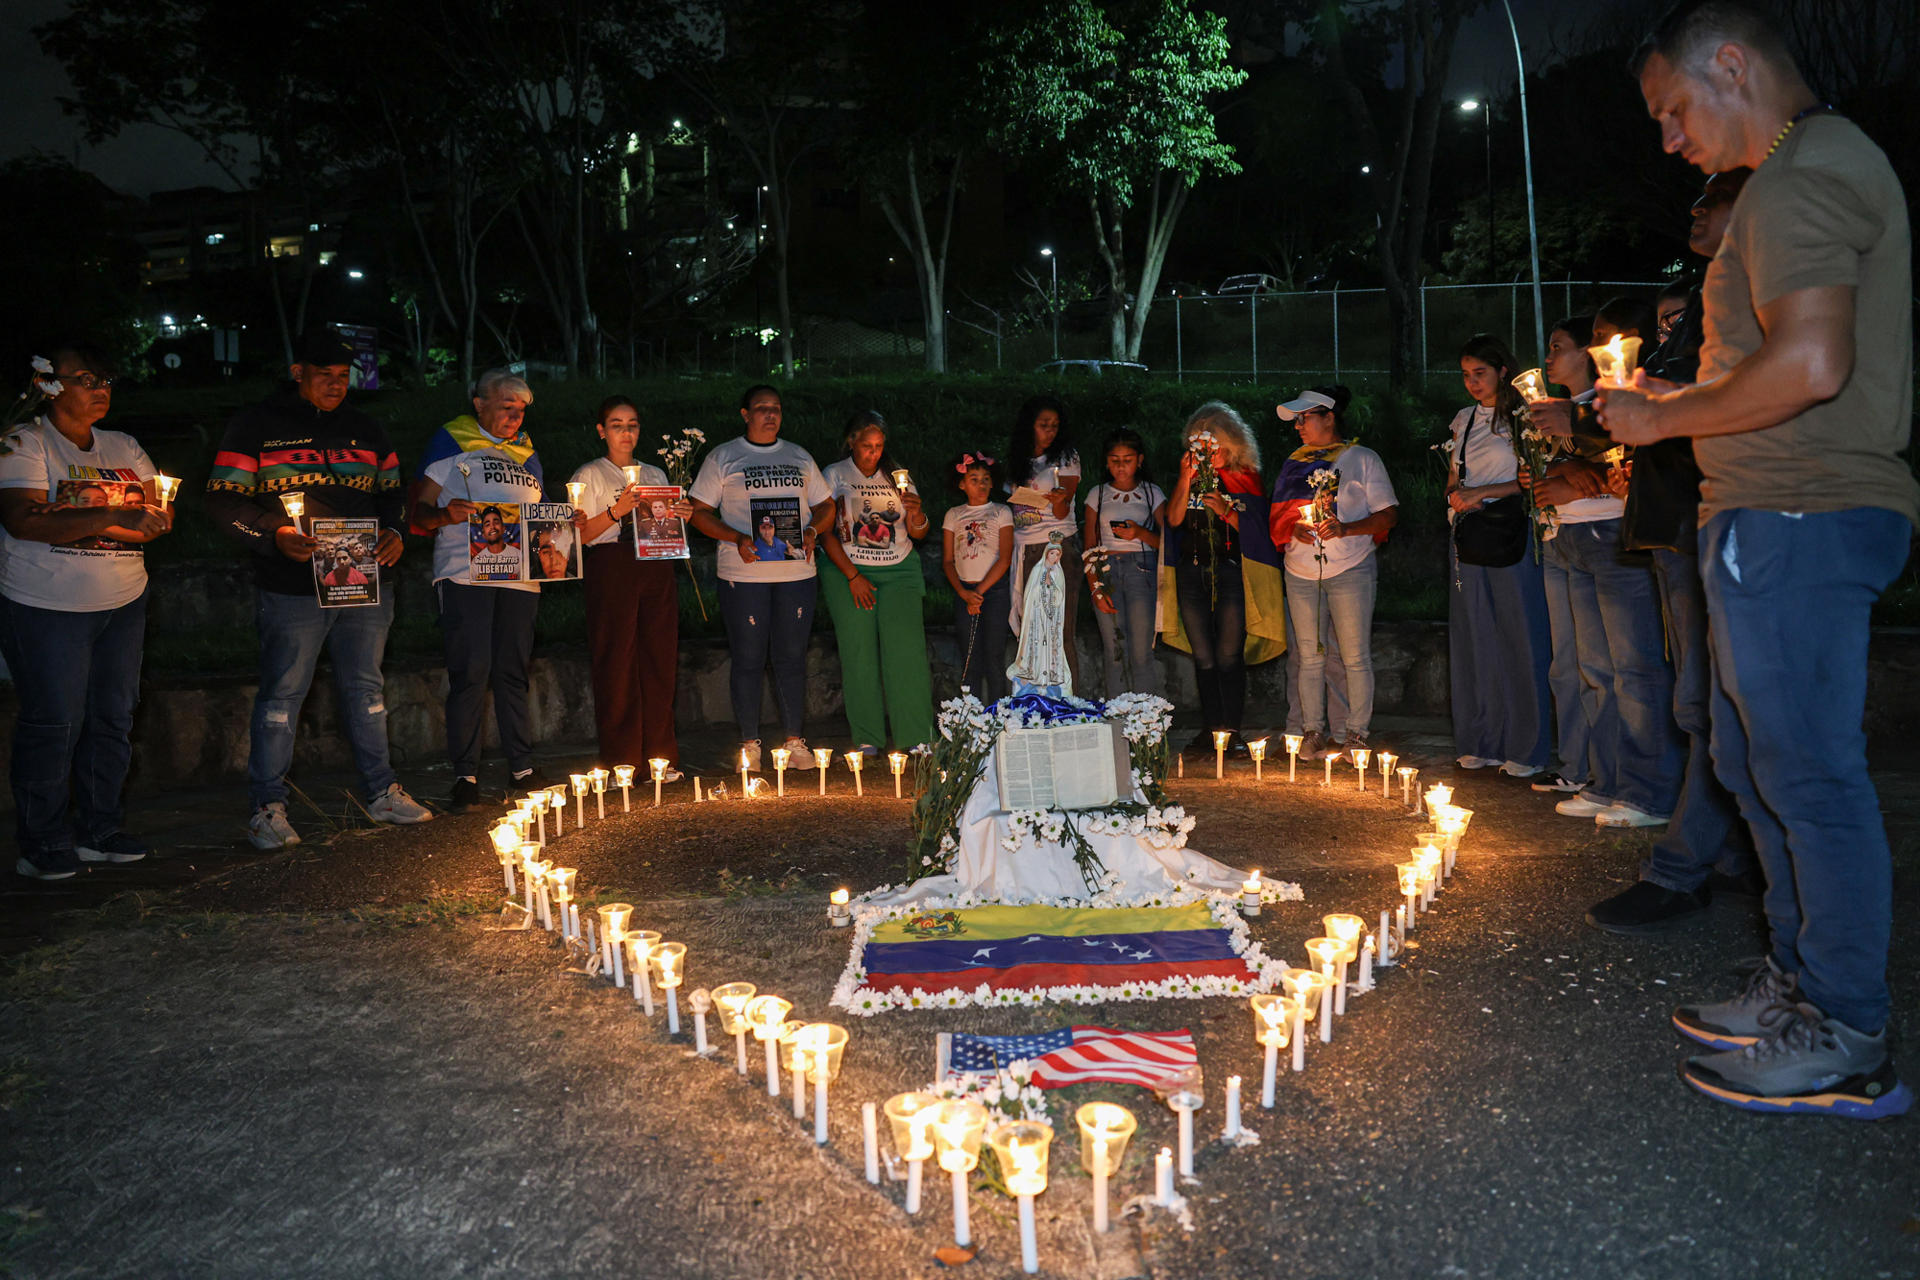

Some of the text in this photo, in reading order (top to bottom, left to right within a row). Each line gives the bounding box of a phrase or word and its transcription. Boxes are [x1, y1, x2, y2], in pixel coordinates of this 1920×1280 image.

[483, 462, 505, 471] LOS
[743, 470, 764, 479] LOS
[523, 503, 575, 520] LIBERTAD
